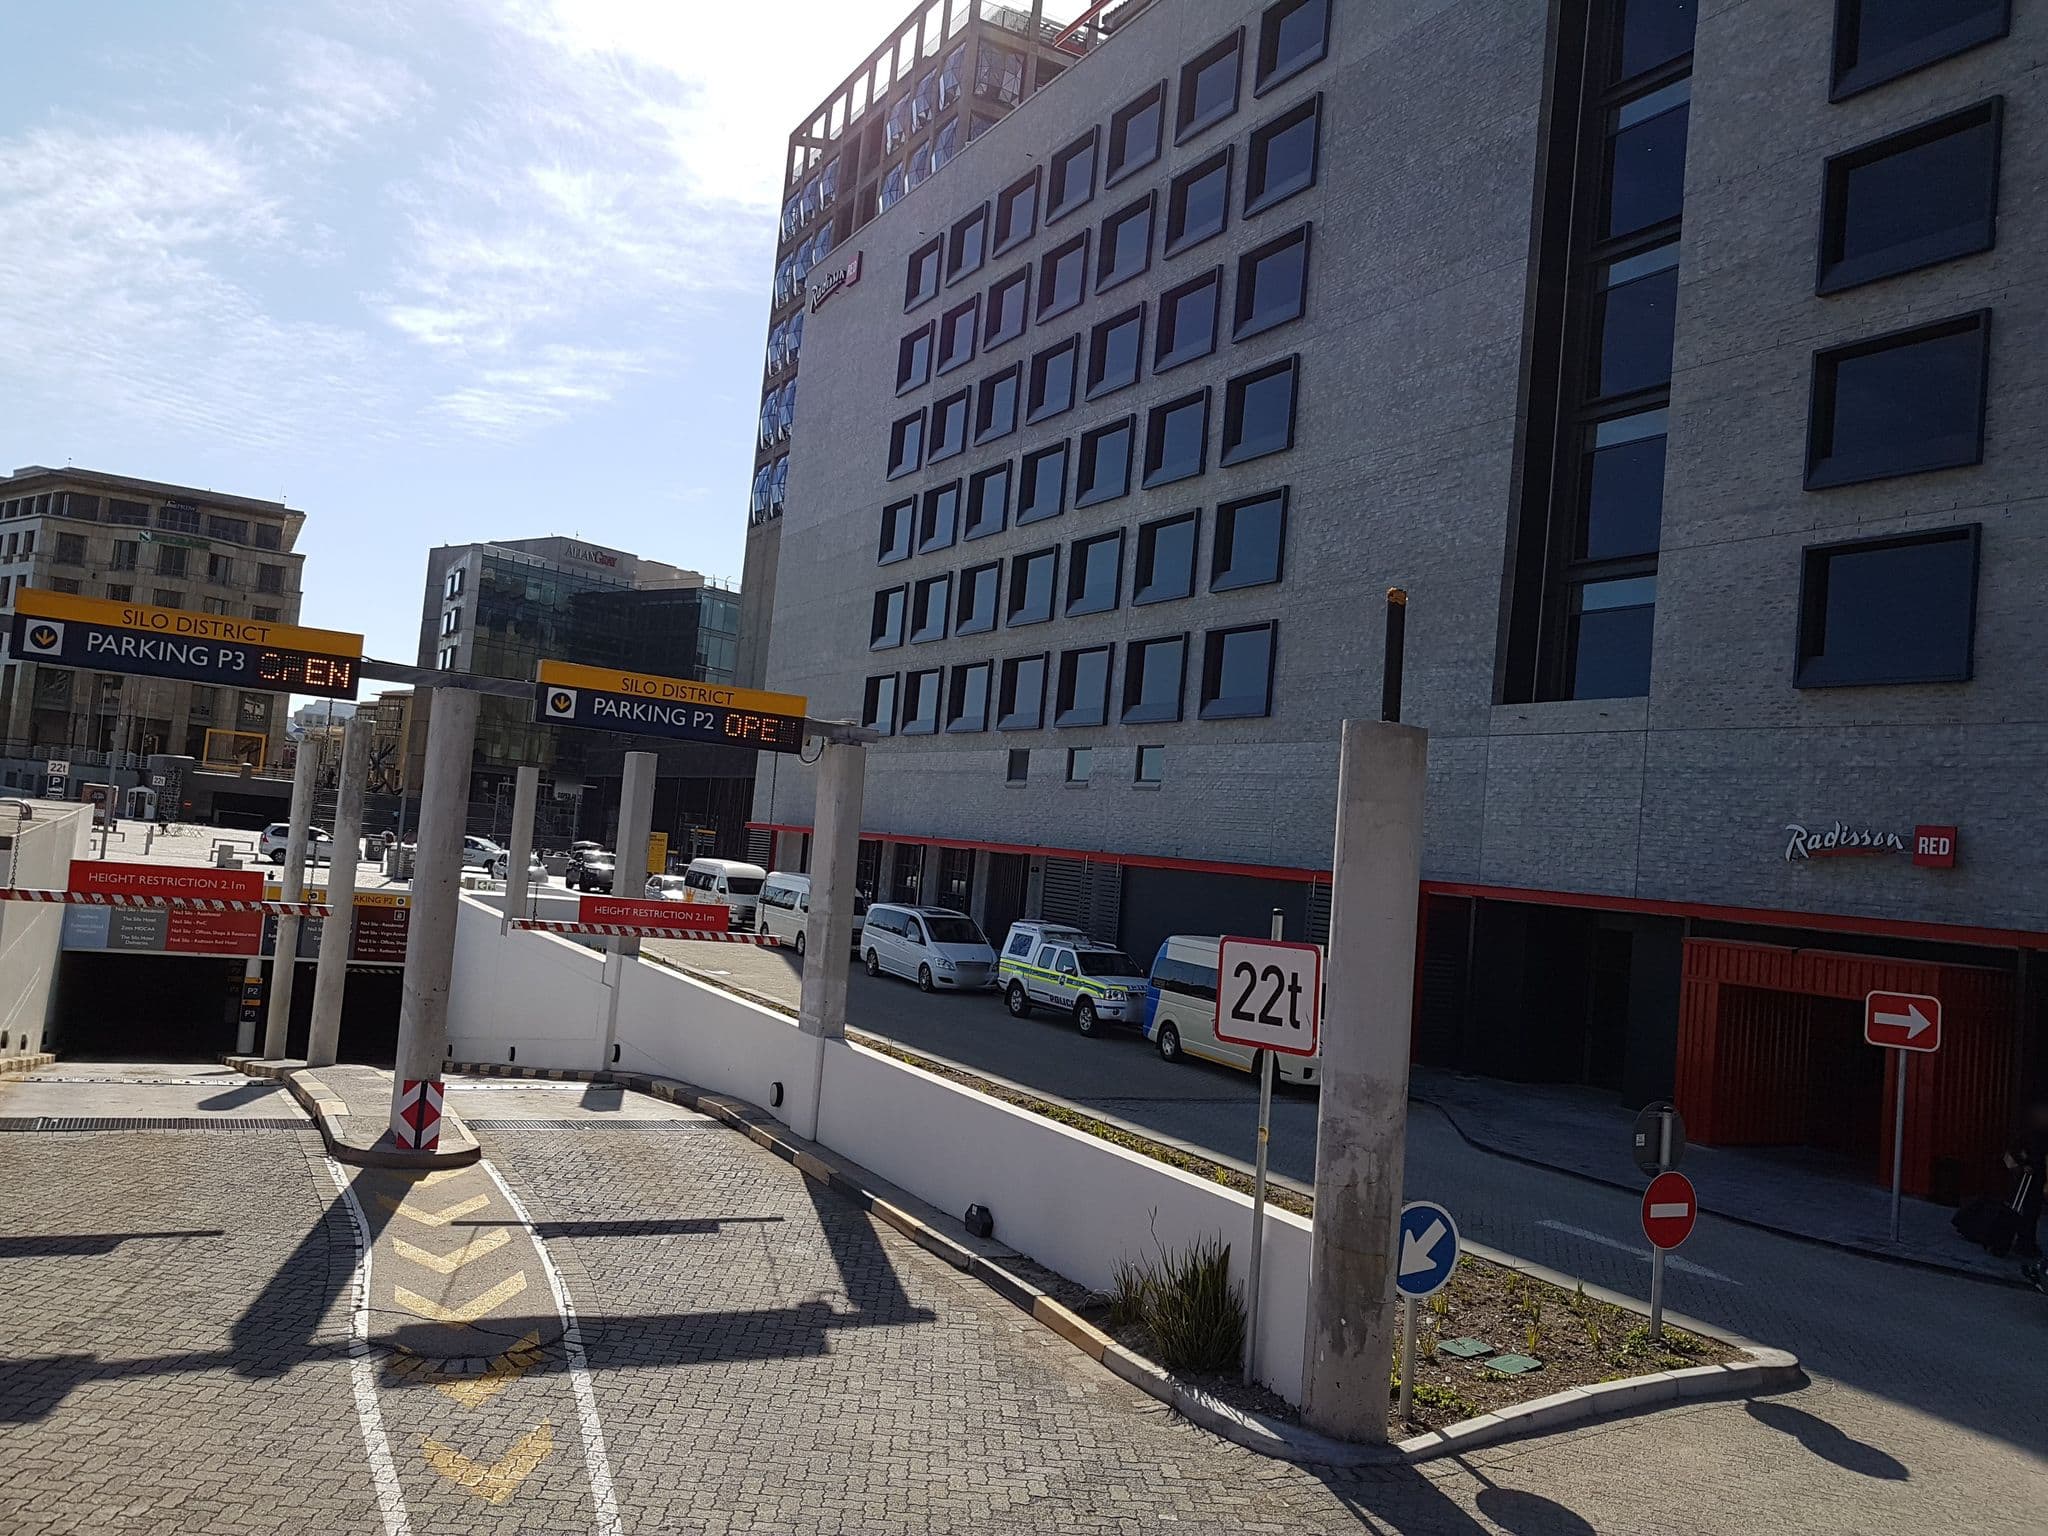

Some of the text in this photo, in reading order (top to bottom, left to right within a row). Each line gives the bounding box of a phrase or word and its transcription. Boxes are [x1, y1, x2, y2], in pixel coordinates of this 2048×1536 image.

[122, 609, 271, 643] SILO DISTRICT
[87, 632, 246, 671] PARKING P3
[621, 677, 735, 705] SILO DISTRICT
[593, 697, 715, 730] PARKING P2
[1785, 820, 1950, 862] Radisson RED
[88, 872, 246, 891] HEIGHT RESTRICTION 2.1m
[594, 906, 715, 922] HEIGHT RESTRICTION 2.1m
[247, 987, 258, 995] P2
[1231, 961, 1303, 1030] 22t
[245, 1010, 256, 1018] P3
